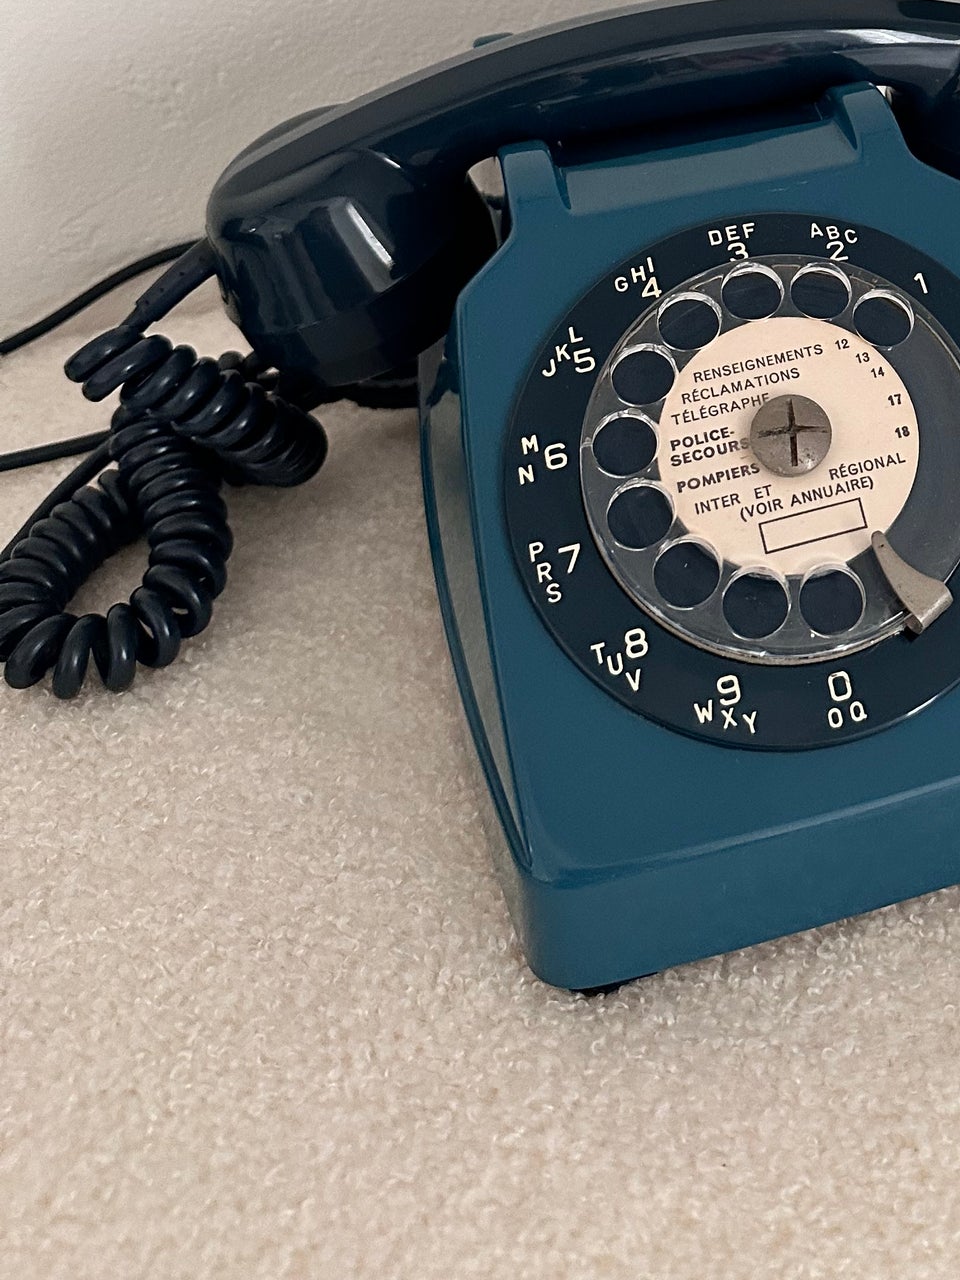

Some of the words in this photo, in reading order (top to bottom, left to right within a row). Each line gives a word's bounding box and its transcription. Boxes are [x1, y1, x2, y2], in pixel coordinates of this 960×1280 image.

[708, 223, 755, 245] DEF
[810, 223, 858, 244] ABC
[727, 242, 749, 262] 3
[826, 240, 849, 261] 2
[614, 257, 654, 292] GHI
[641, 277, 662, 298] 4
[913, 272, 928, 294] 1
[573, 348, 596, 373] 5
[693, 344, 824, 383] RENSEIGNEMENTS
[835, 338, 850, 350] 12
[871, 366, 886, 378] 14
[681, 367, 801, 405] RÉCLAMATIONS
[855, 352, 871, 363] 13
[670, 427, 735, 451] POLICE-
[887, 393, 902, 406] 17
[543, 443, 568, 470] 6
[670, 437, 749, 467] SECOURS
[895, 425, 911, 438] 18
[676, 463, 760, 493] POMPIERS
[694, 493, 741, 515] INTER
[754, 484, 773, 499] ET
[829, 452, 907, 481] RÉGIONAL
[740, 499, 784, 522] (VOIR
[790, 475, 875, 508] ANNUAIRE)
[557, 543, 581, 574] 7
[624, 628, 648, 659] 8
[716, 674, 742, 705] 9
[693, 699, 757, 734] WXY
